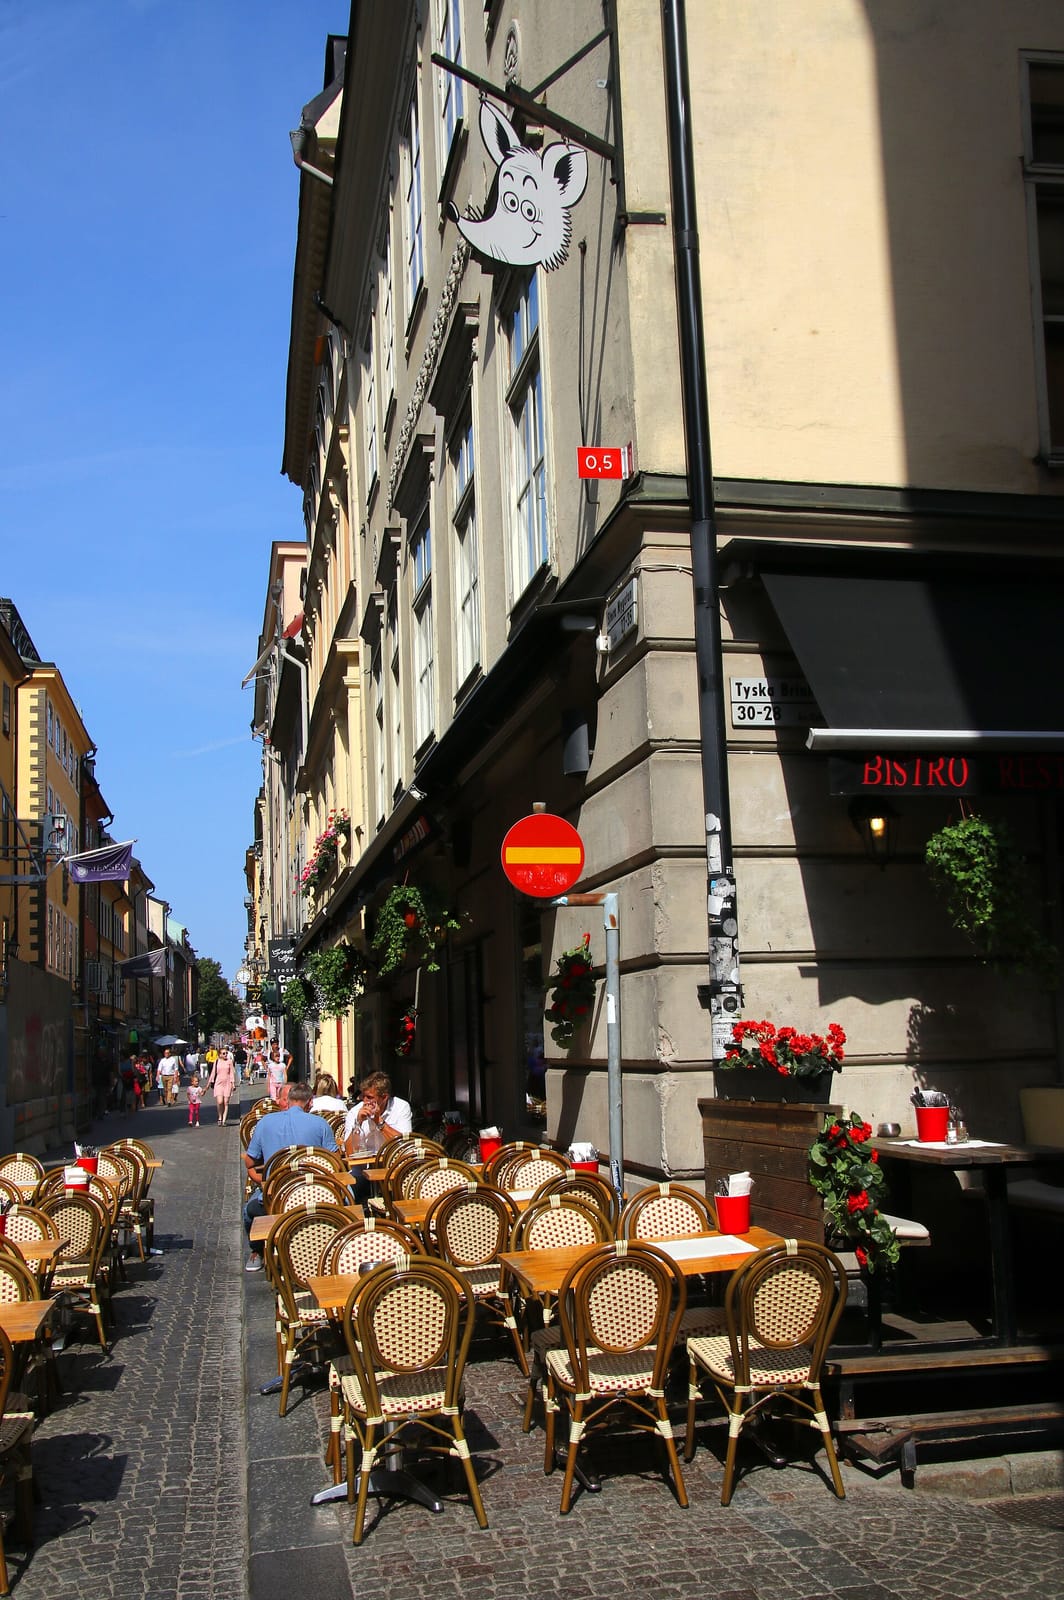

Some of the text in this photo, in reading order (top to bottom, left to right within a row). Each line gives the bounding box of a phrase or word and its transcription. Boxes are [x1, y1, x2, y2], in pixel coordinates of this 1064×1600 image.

[585, 455, 613, 473] 0,5
[735, 682, 774, 699] Tyska
[737, 706, 781, 720] 30-28
[861, 753, 969, 788] BISTRO
